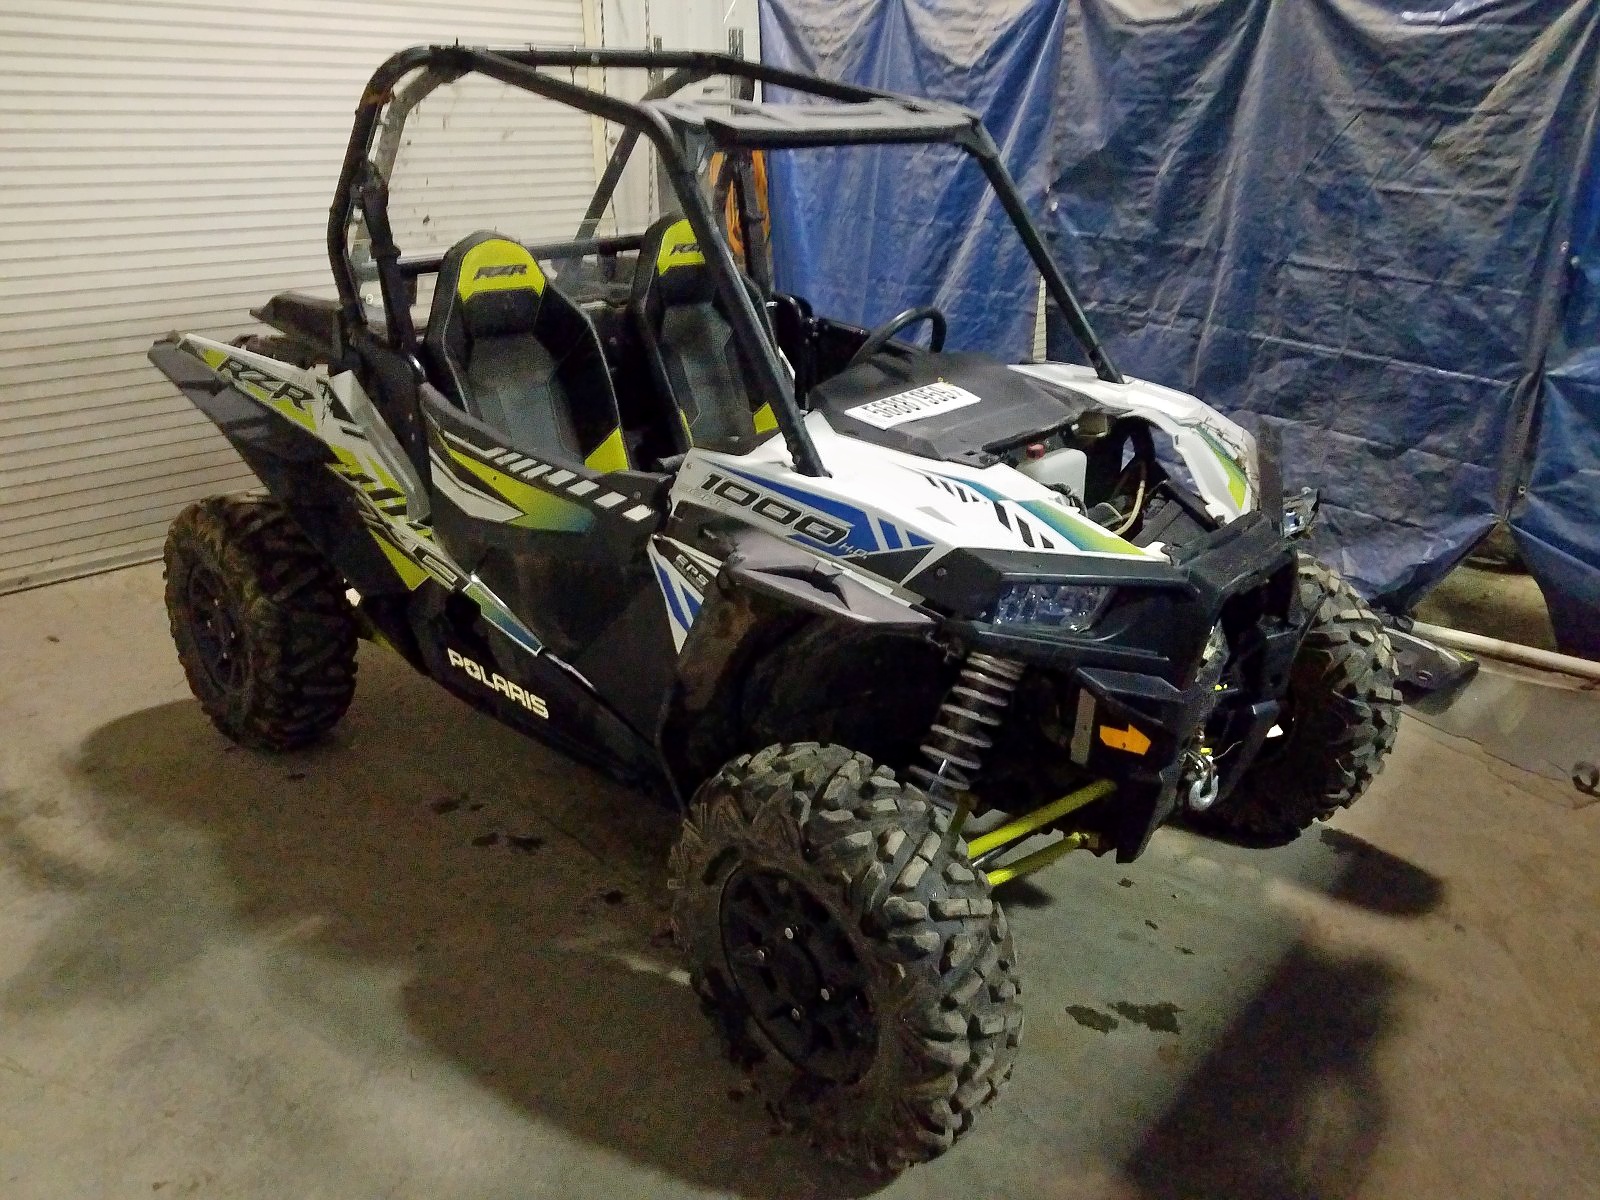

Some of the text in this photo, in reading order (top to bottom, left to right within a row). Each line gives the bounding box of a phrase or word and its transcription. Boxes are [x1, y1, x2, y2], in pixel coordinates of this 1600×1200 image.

[473, 263, 528, 281] RZR
[217, 355, 316, 411] RZR
[700, 472, 851, 546] 1000
[447, 647, 549, 719] POLARIS
